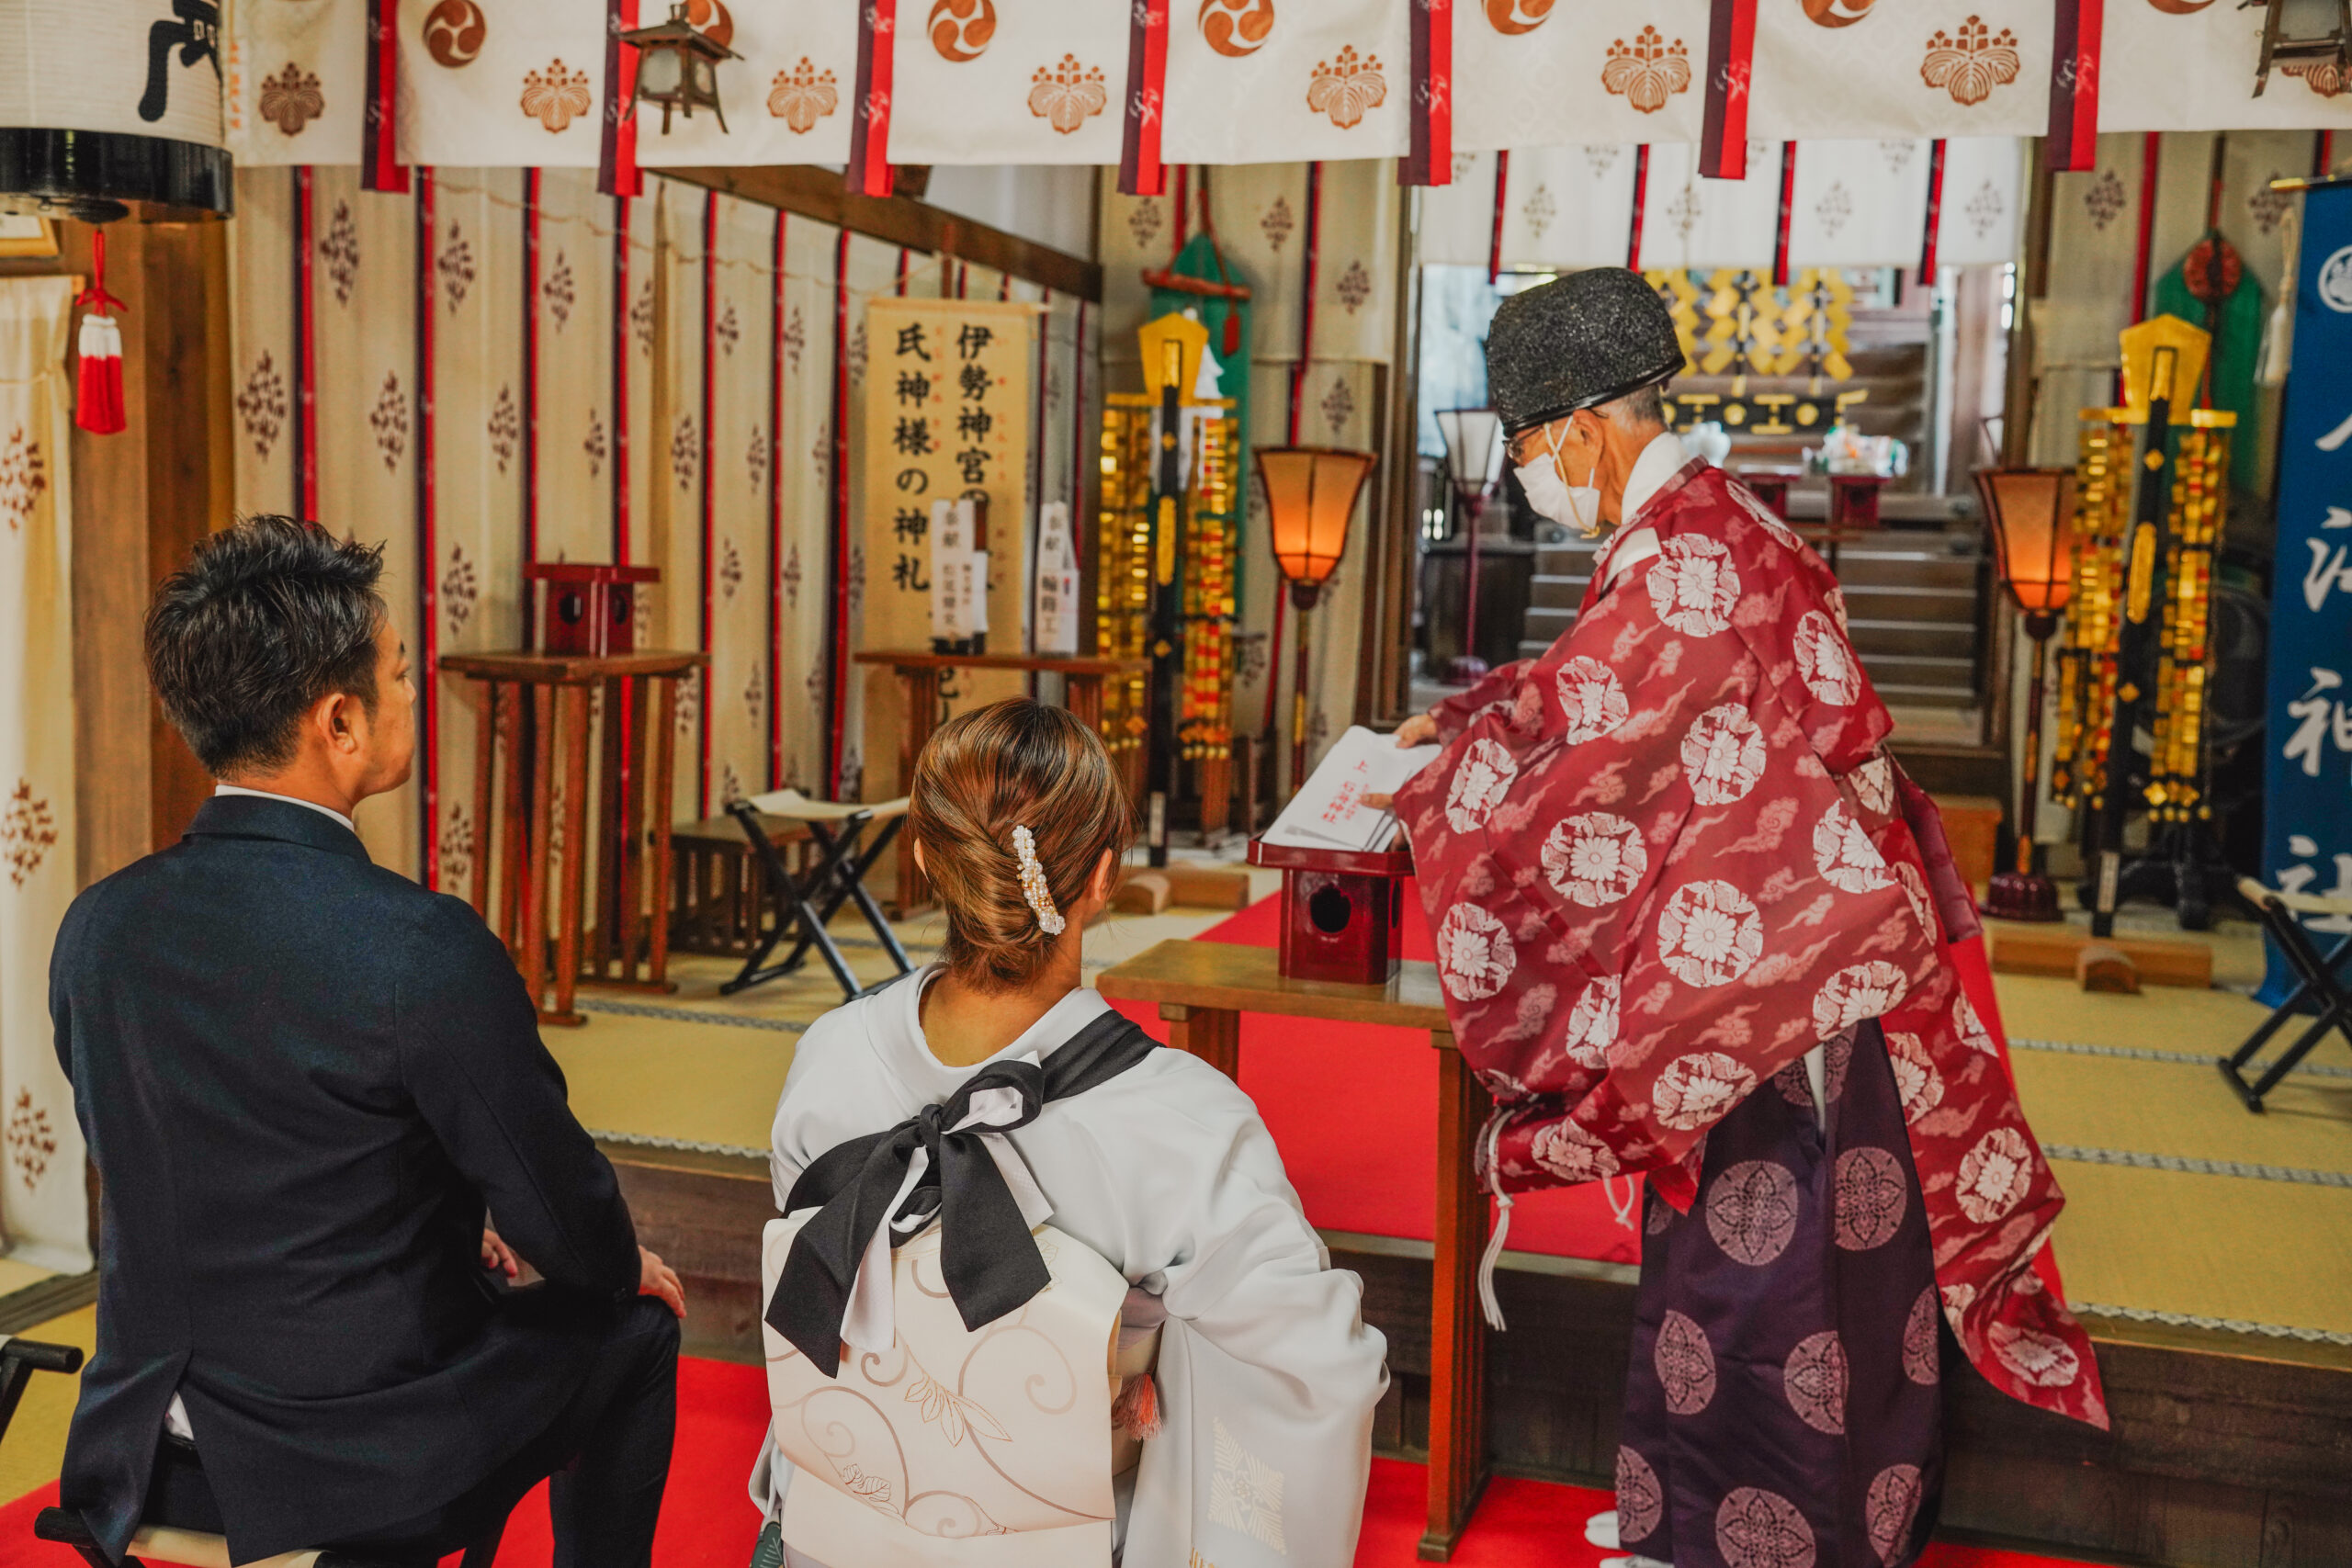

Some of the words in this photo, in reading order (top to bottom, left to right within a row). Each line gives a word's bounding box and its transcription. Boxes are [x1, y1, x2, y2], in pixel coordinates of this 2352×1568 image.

[893, 322, 933, 592] 氏神様の神札
